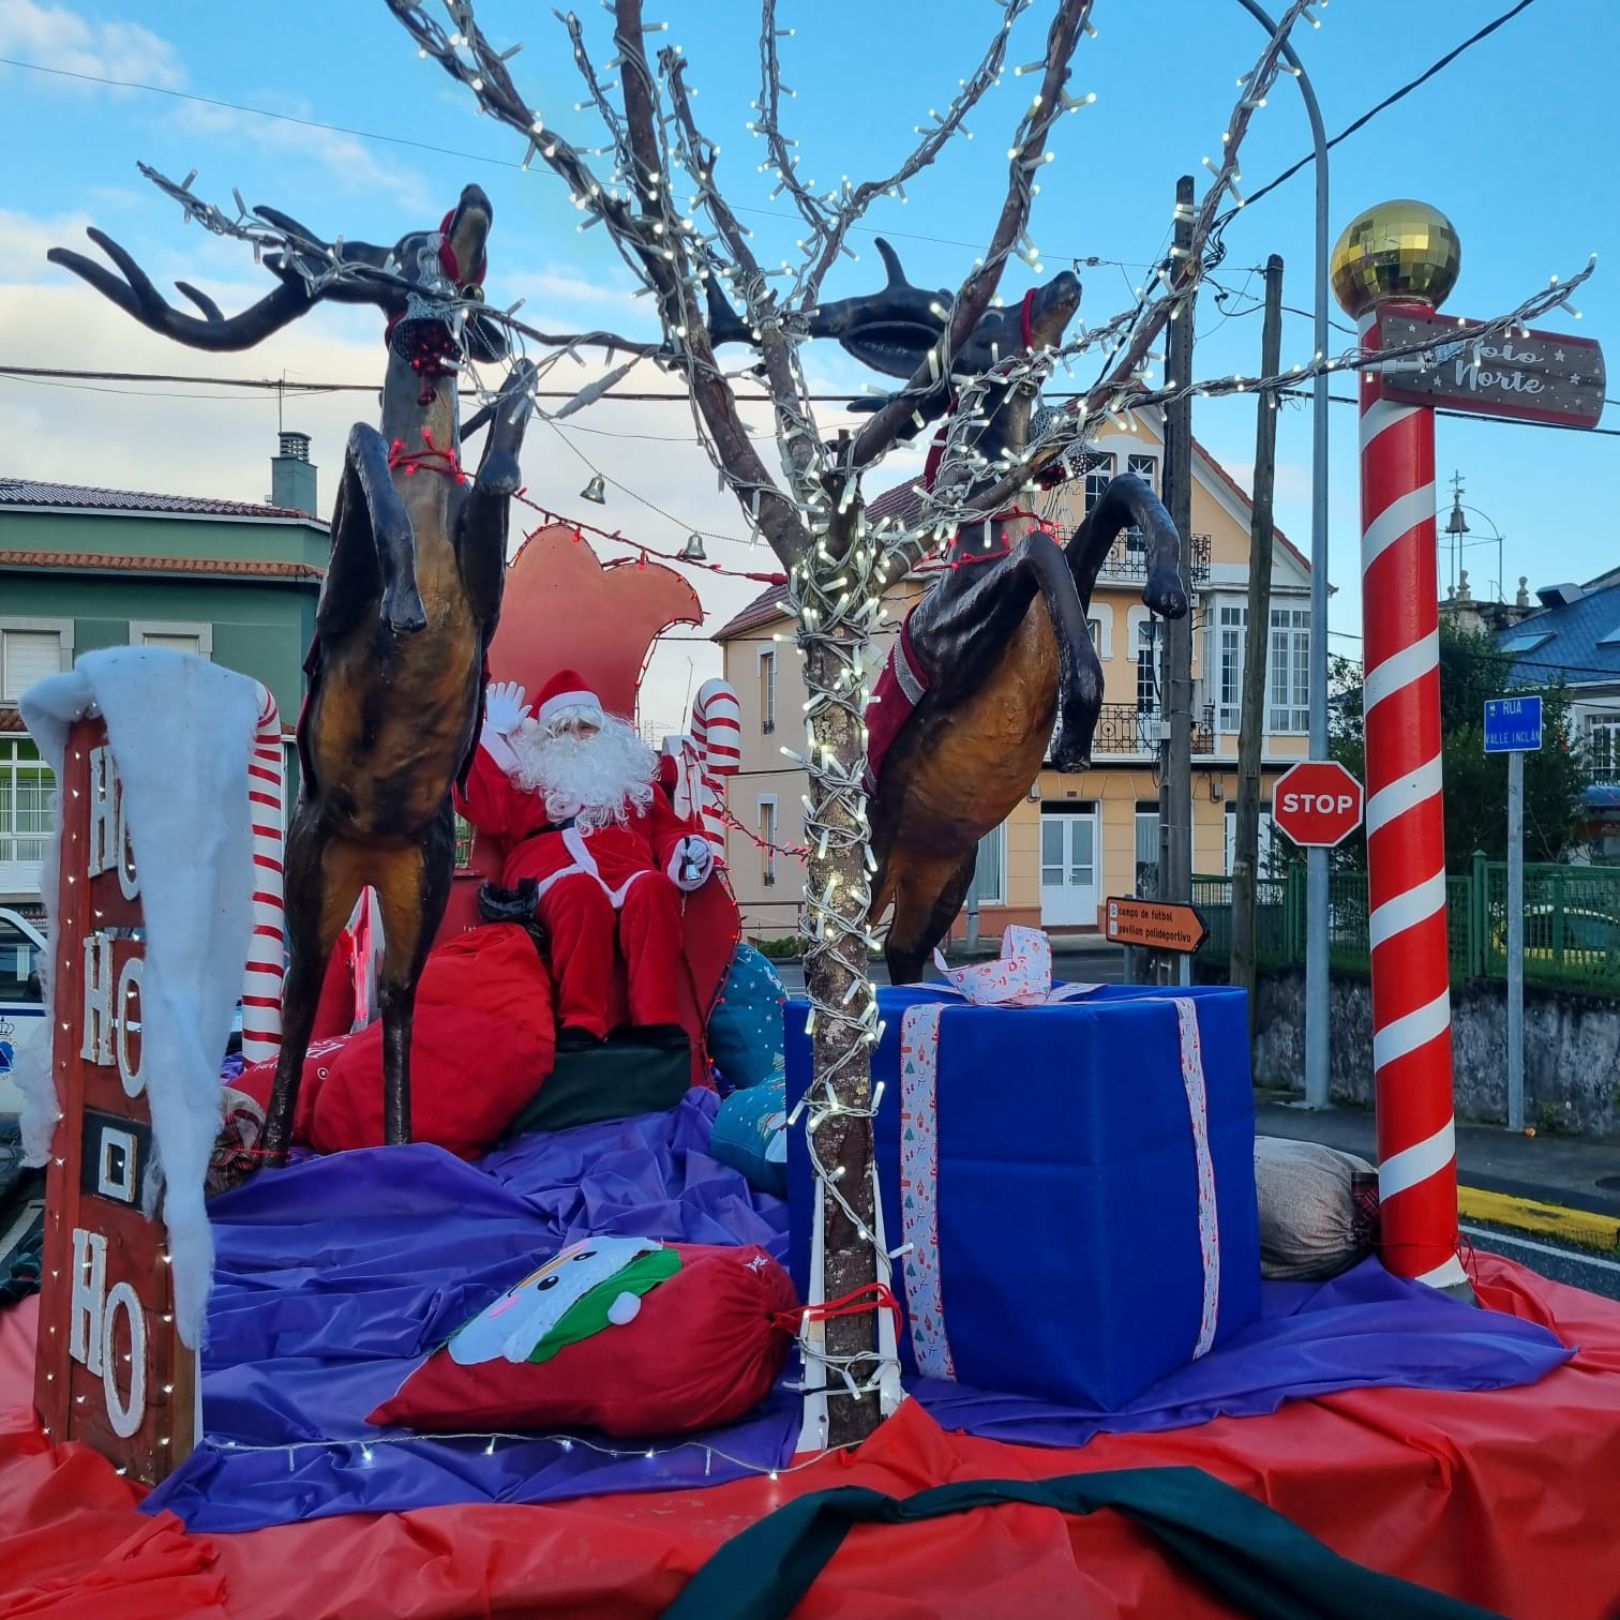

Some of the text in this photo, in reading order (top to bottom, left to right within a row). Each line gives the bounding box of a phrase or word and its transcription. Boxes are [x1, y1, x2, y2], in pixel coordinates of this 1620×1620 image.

[1455, 360, 1545, 394] Norte
[1282, 793, 1353, 814] STOP
[1119, 907, 1138, 919] campo
[1140, 909, 1149, 918] de
[1145, 928, 1191, 943] polideportivo
[79, 931, 147, 1098] HO
[69, 1228, 147, 1438] HO
